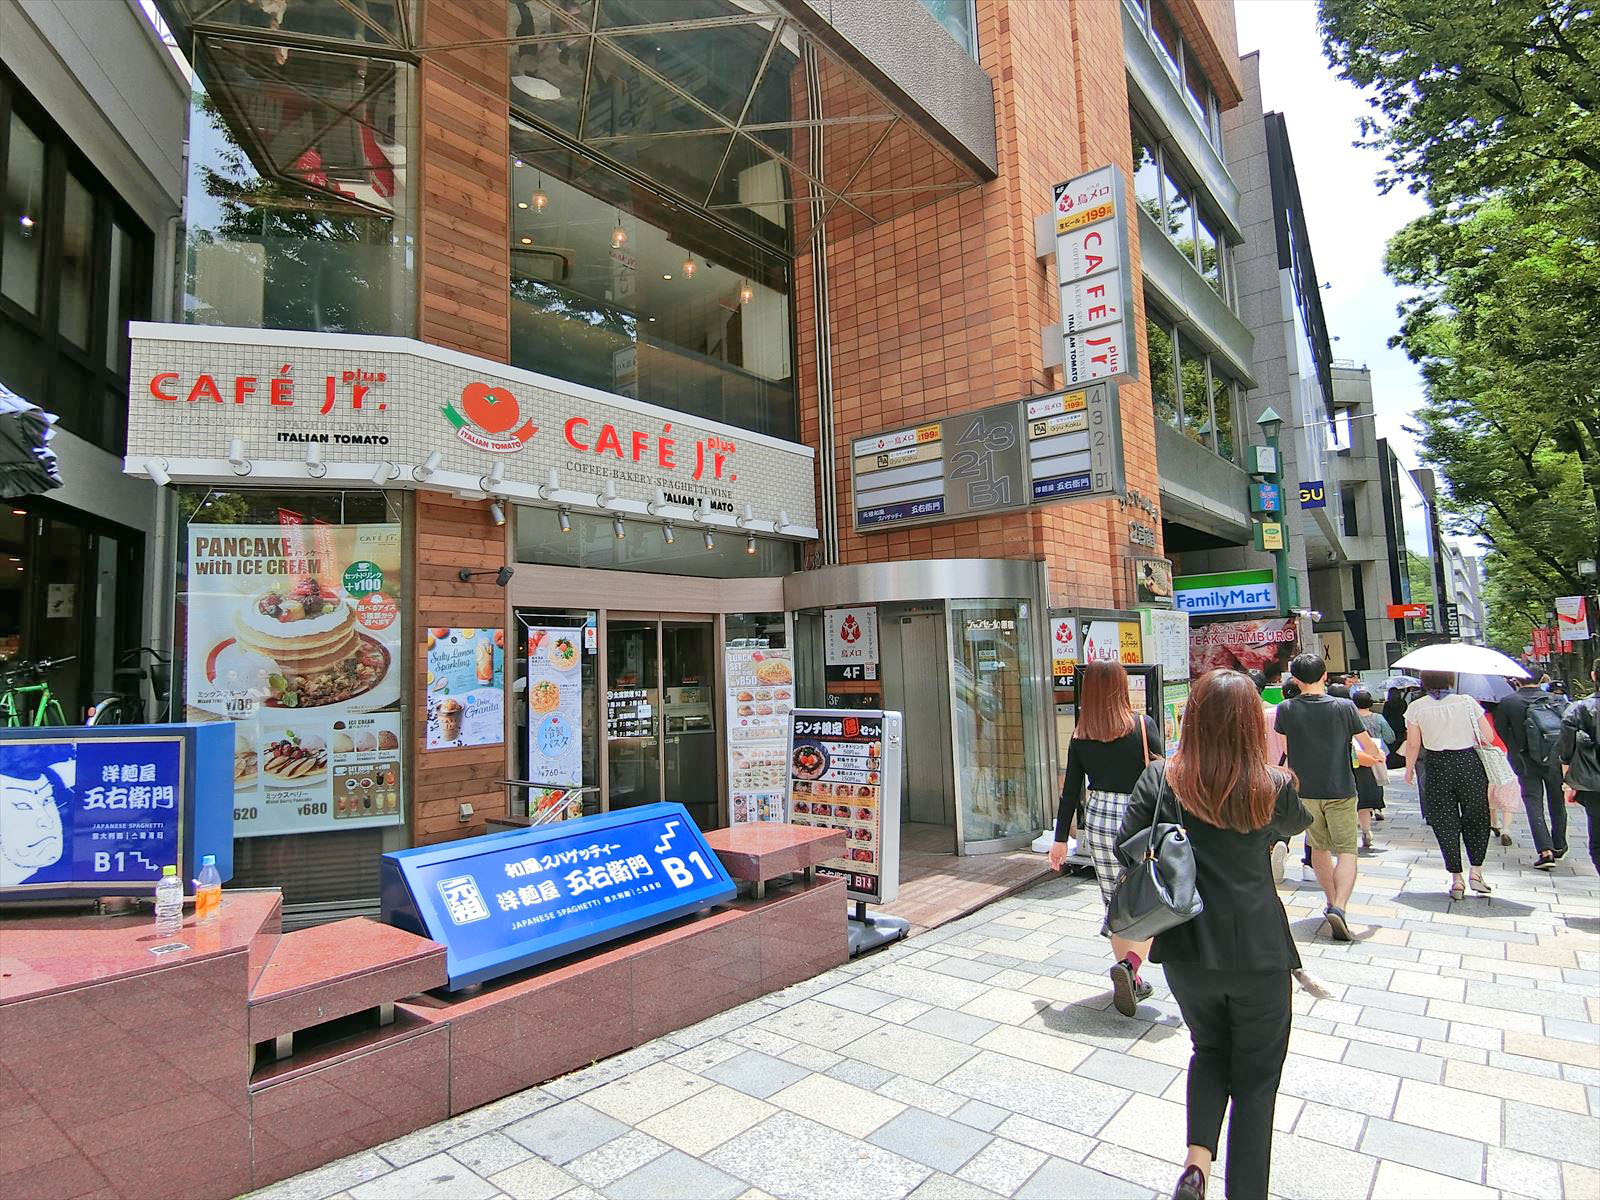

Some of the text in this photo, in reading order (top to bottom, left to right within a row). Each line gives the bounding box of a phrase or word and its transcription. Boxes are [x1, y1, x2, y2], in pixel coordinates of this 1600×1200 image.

[1084, 232, 1116, 321] CAFÉ
[1069, 352, 1078, 382] TOMATO
[1108, 346, 1118, 373] plus
[342, 369, 387, 384] plus
[150, 364, 387, 415] CAFÉ Jr.
[1091, 390, 1101, 403] 4
[1092, 410, 1103, 425] 3
[278, 432, 389, 445] ITALIAN TOMATO
[461, 430, 521, 450] ITALIAN TOMATO
[707, 435, 736, 453] plus
[1094, 431, 1104, 446] 2
[563, 416, 737, 481] CAFÉ Jr.
[1097, 452, 1102, 466] 1
[1096, 472, 1108, 488] B1
[664, 492, 733, 512] TALIAN TMATO
[1299, 487, 1324, 502] GU
[196, 537, 292, 557] PANCAKE
[196, 559, 320, 575] with ICE CREAM
[344, 572, 382, 580] セットドリンク
[1176, 588, 1271, 608] FamilyMart
[1447, 606, 1458, 635] LUSH
[1189, 635, 1219, 646] TEAK
[1227, 629, 1295, 645] HAMBURG
[843, 667, 861, 679] 4F
[1059, 676, 1074, 686] 4F
[860, 725, 881, 737] セット
[83, 786, 174, 810] 五右衛門
[265, 791, 309, 799] ミックスベリー
[298, 802, 327, 816] ¥680
[94, 851, 125, 872] B1
[505, 843, 621, 878] 和風スパゲッティー
[563, 853, 653, 897] 五右衛門
[661, 850, 713, 889] B1
[855, 875, 866, 887] B1
[511, 899, 601, 930] JAPANESE SPAGHETTI
